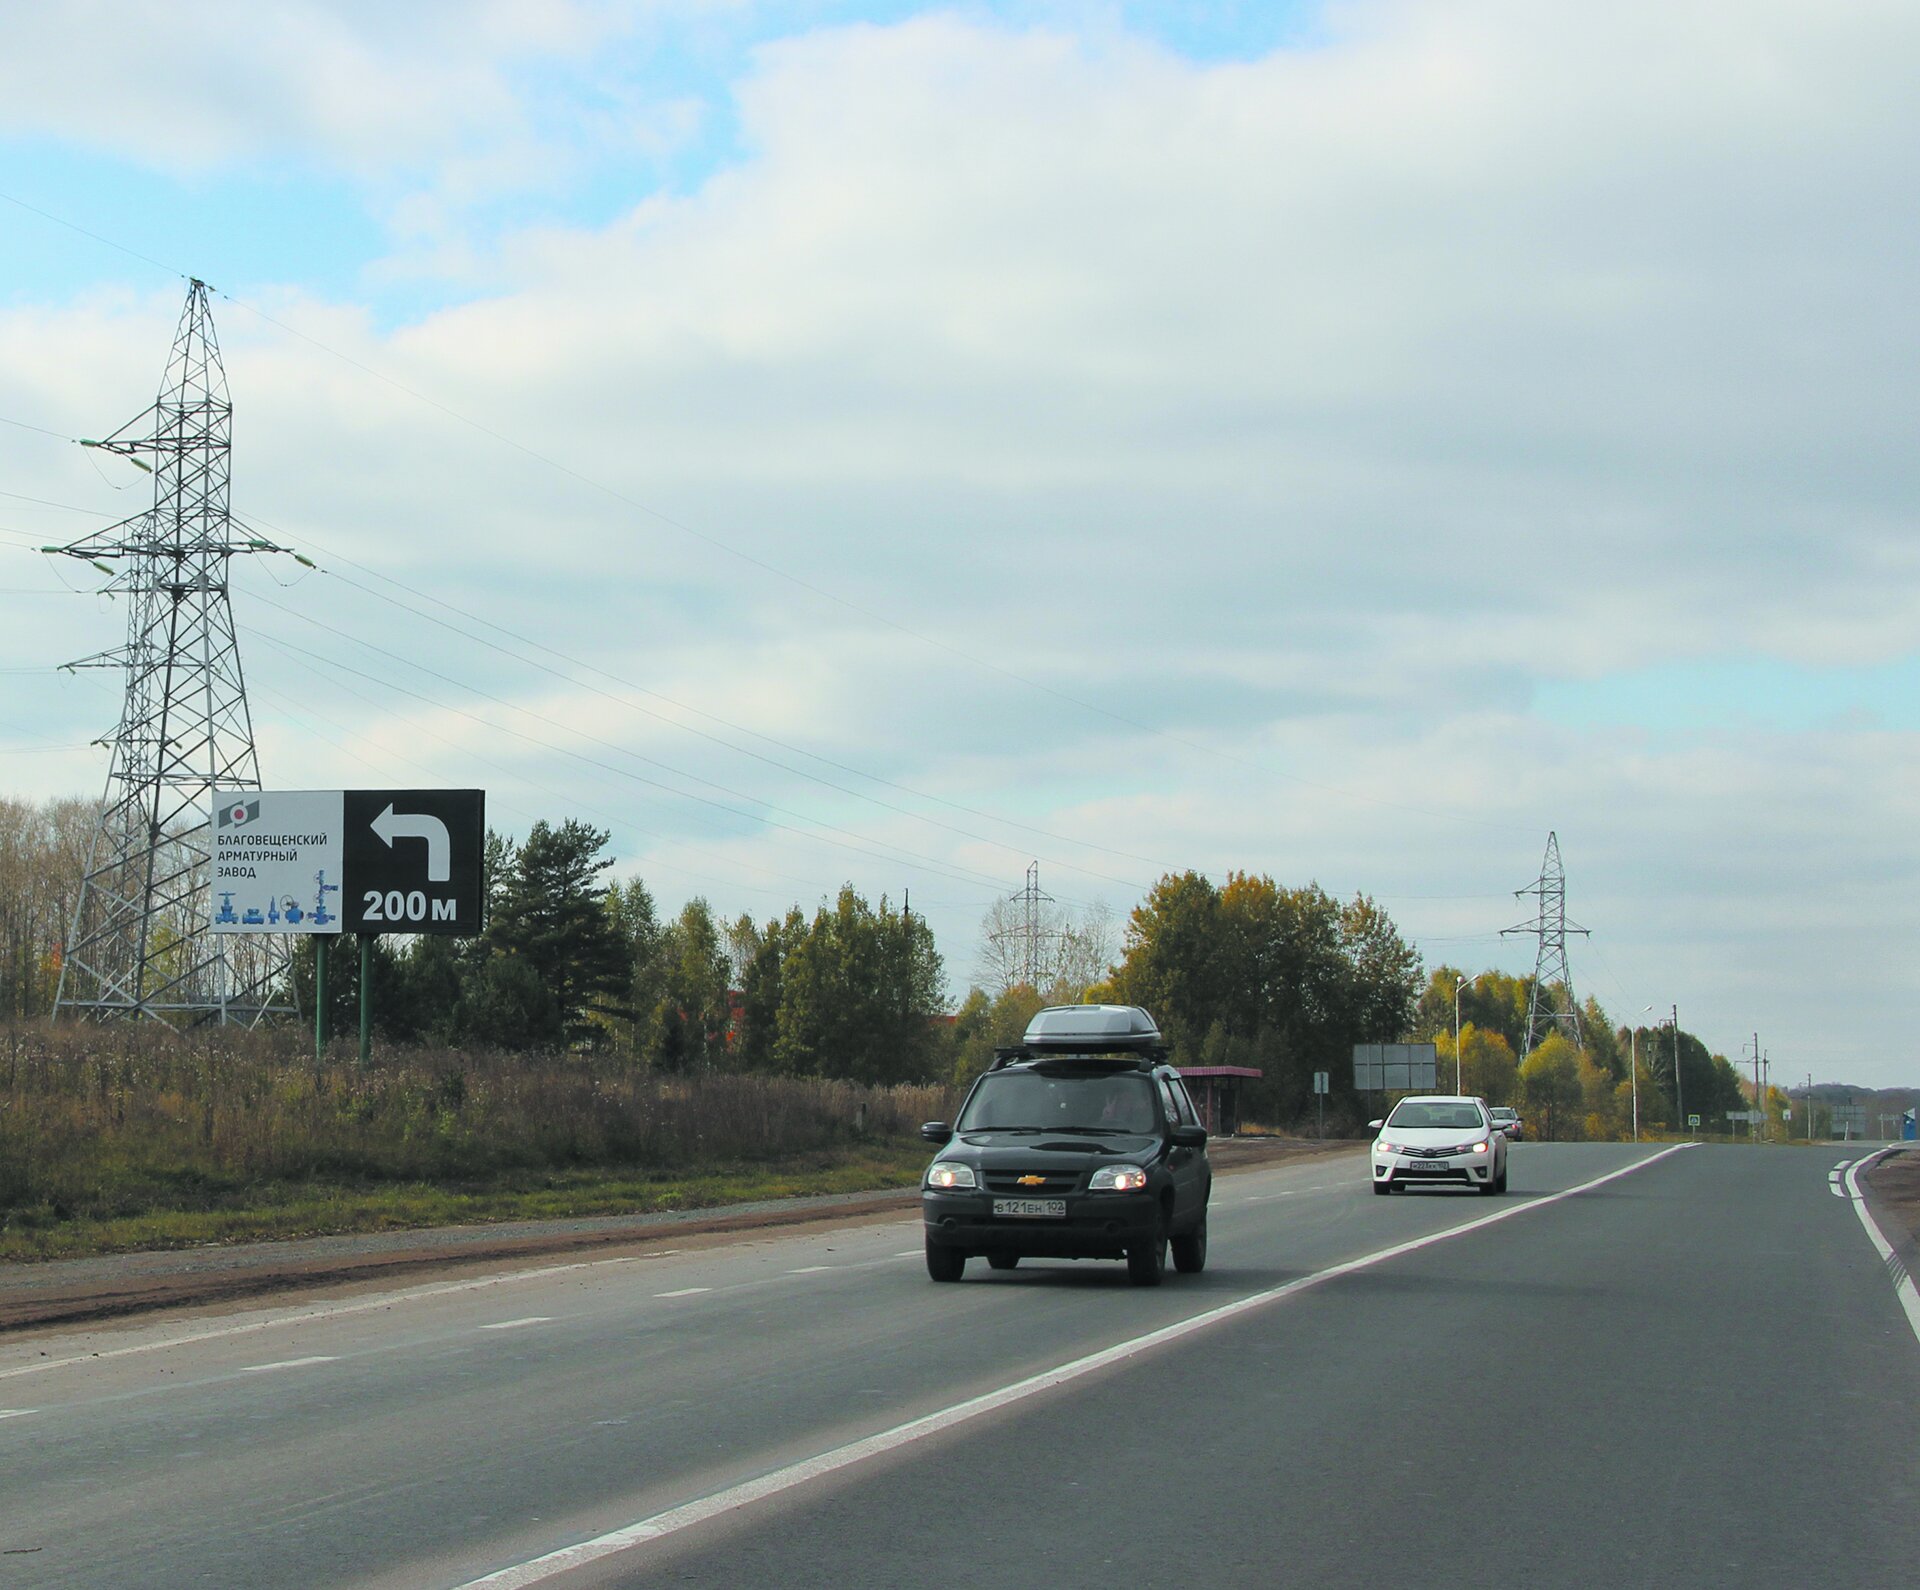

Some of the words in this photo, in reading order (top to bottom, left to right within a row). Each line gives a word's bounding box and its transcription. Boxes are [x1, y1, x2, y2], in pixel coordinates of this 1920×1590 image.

[218, 834, 327, 846] БЛАГОВЕЩЕНСКИЙ
[218, 850, 298, 862] АРМАТУРНЫЙ
[218, 866, 257, 879] ЗАВОД
